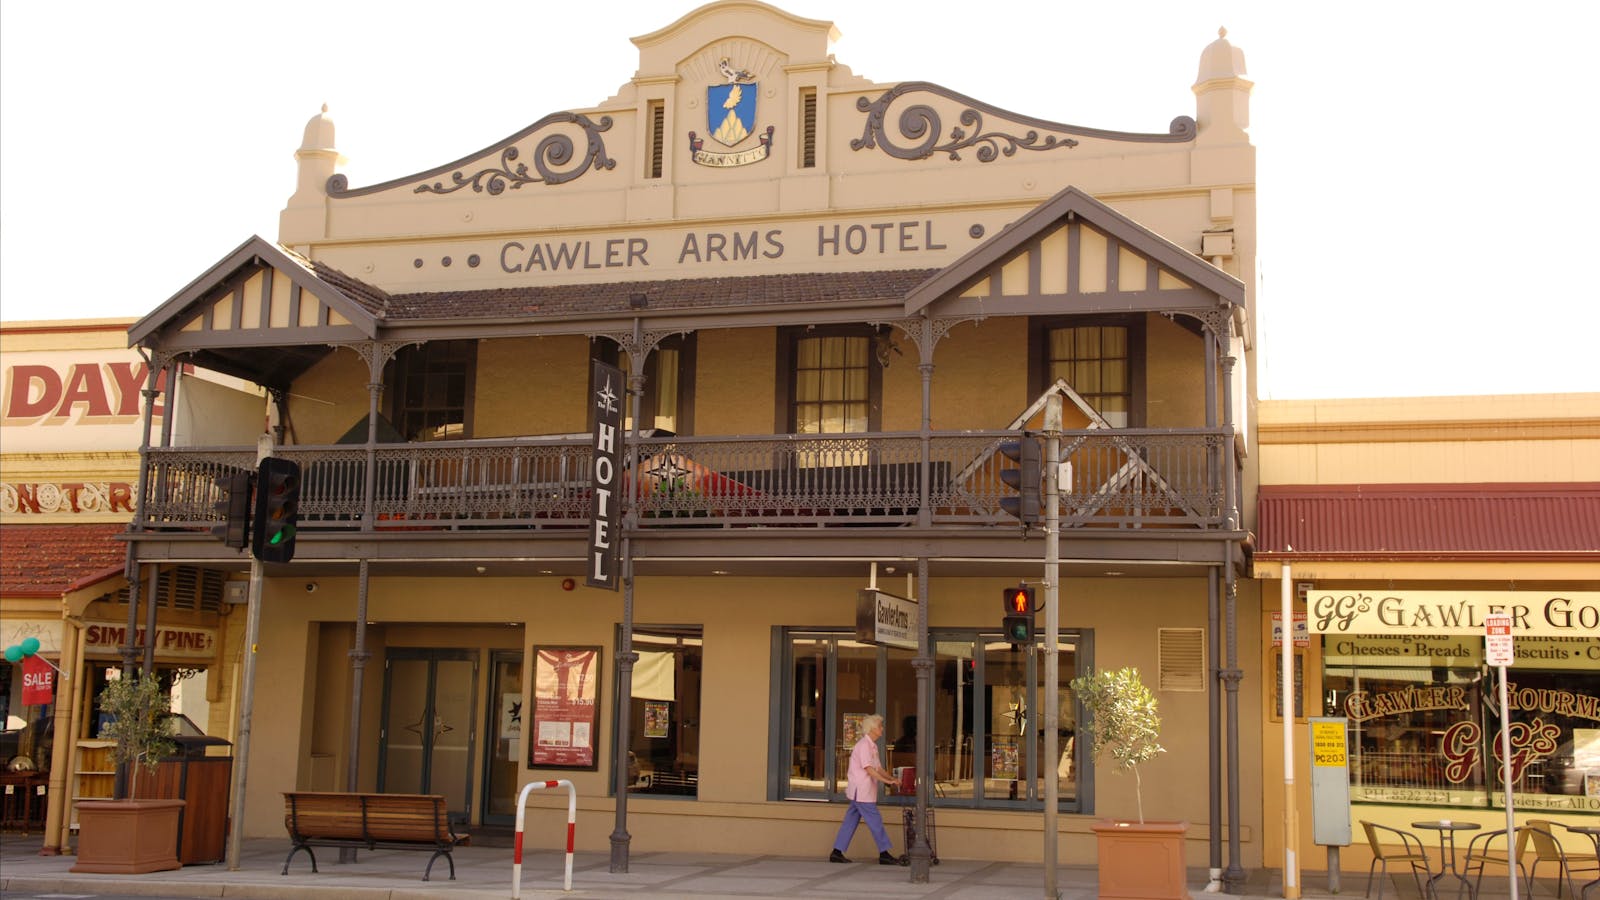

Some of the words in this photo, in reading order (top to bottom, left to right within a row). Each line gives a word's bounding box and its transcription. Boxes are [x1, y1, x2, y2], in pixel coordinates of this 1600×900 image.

[500, 237, 650, 274] GAWLER
[678, 229, 785, 264] ARMS
[817, 219, 948, 257] HOTEL
[593, 422, 615, 582] HOTEL
[1336, 641, 1400, 656] Cheeses
[1415, 643, 1471, 657] Breads
[1513, 645, 1569, 659] iscuits
[23, 672, 52, 687] SALE
[1344, 684, 1467, 722] GAWLER
[1494, 682, 1600, 721] GOURM
